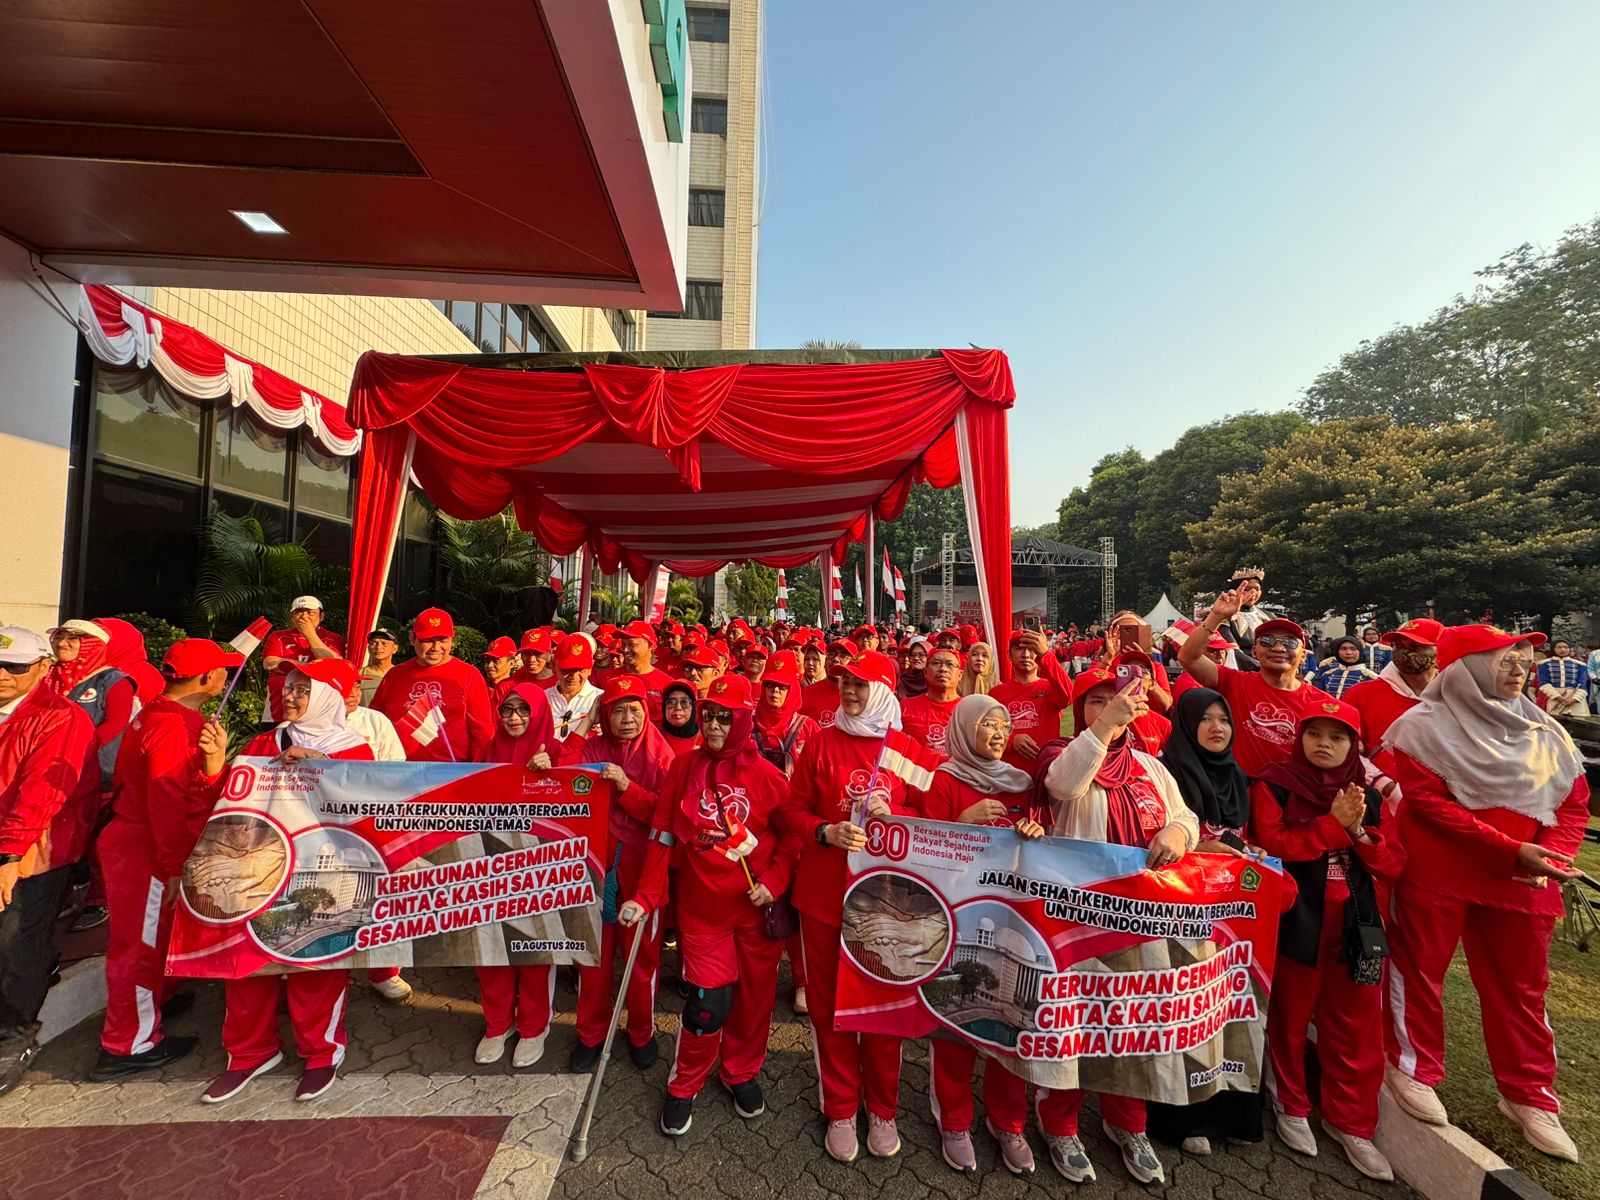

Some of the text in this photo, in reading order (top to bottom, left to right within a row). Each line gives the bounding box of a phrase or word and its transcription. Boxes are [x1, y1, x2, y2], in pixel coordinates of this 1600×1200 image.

[1253, 701, 1296, 726] 80
[221, 764, 256, 802] 0
[256, 783, 315, 792] Indonesia Maju
[319, 801, 590, 817] JALAN SEHAT KERUKUNAN UMAT BERGAMA
[375, 818, 532, 831] UNTUK INDONESIA EMAS
[864, 817, 910, 861] 80
[913, 833, 985, 853] Rakyat Sejahtera
[914, 825, 991, 844] Bersatu Berdaulat
[377, 838, 586, 896] KERUKUNAN CERMINAN
[911, 844, 975, 864] Indonesia Maju
[374, 862, 585, 920] CINTA & KASIH SAYANG
[978, 871, 1256, 920] JALAN SEHAT KERUKUNAN UMAT BERGAMA
[357, 883, 594, 949] SESAMA UMAT BERAGAMA
[1045, 901, 1212, 937] UNTUK INDONESIA EMAS
[511, 941, 586, 951] 16 AGUSTUS 2025
[1040, 943, 1250, 1000] KERUKUNAN CERMINAN
[1037, 971, 1247, 1029] CINTA & KASIH SAYANG
[1019, 997, 1257, 1059] SESAMA UMAT BERAGAMA
[1190, 1074, 1199, 1086] 16
[1221, 1061, 1244, 1073] 2025
